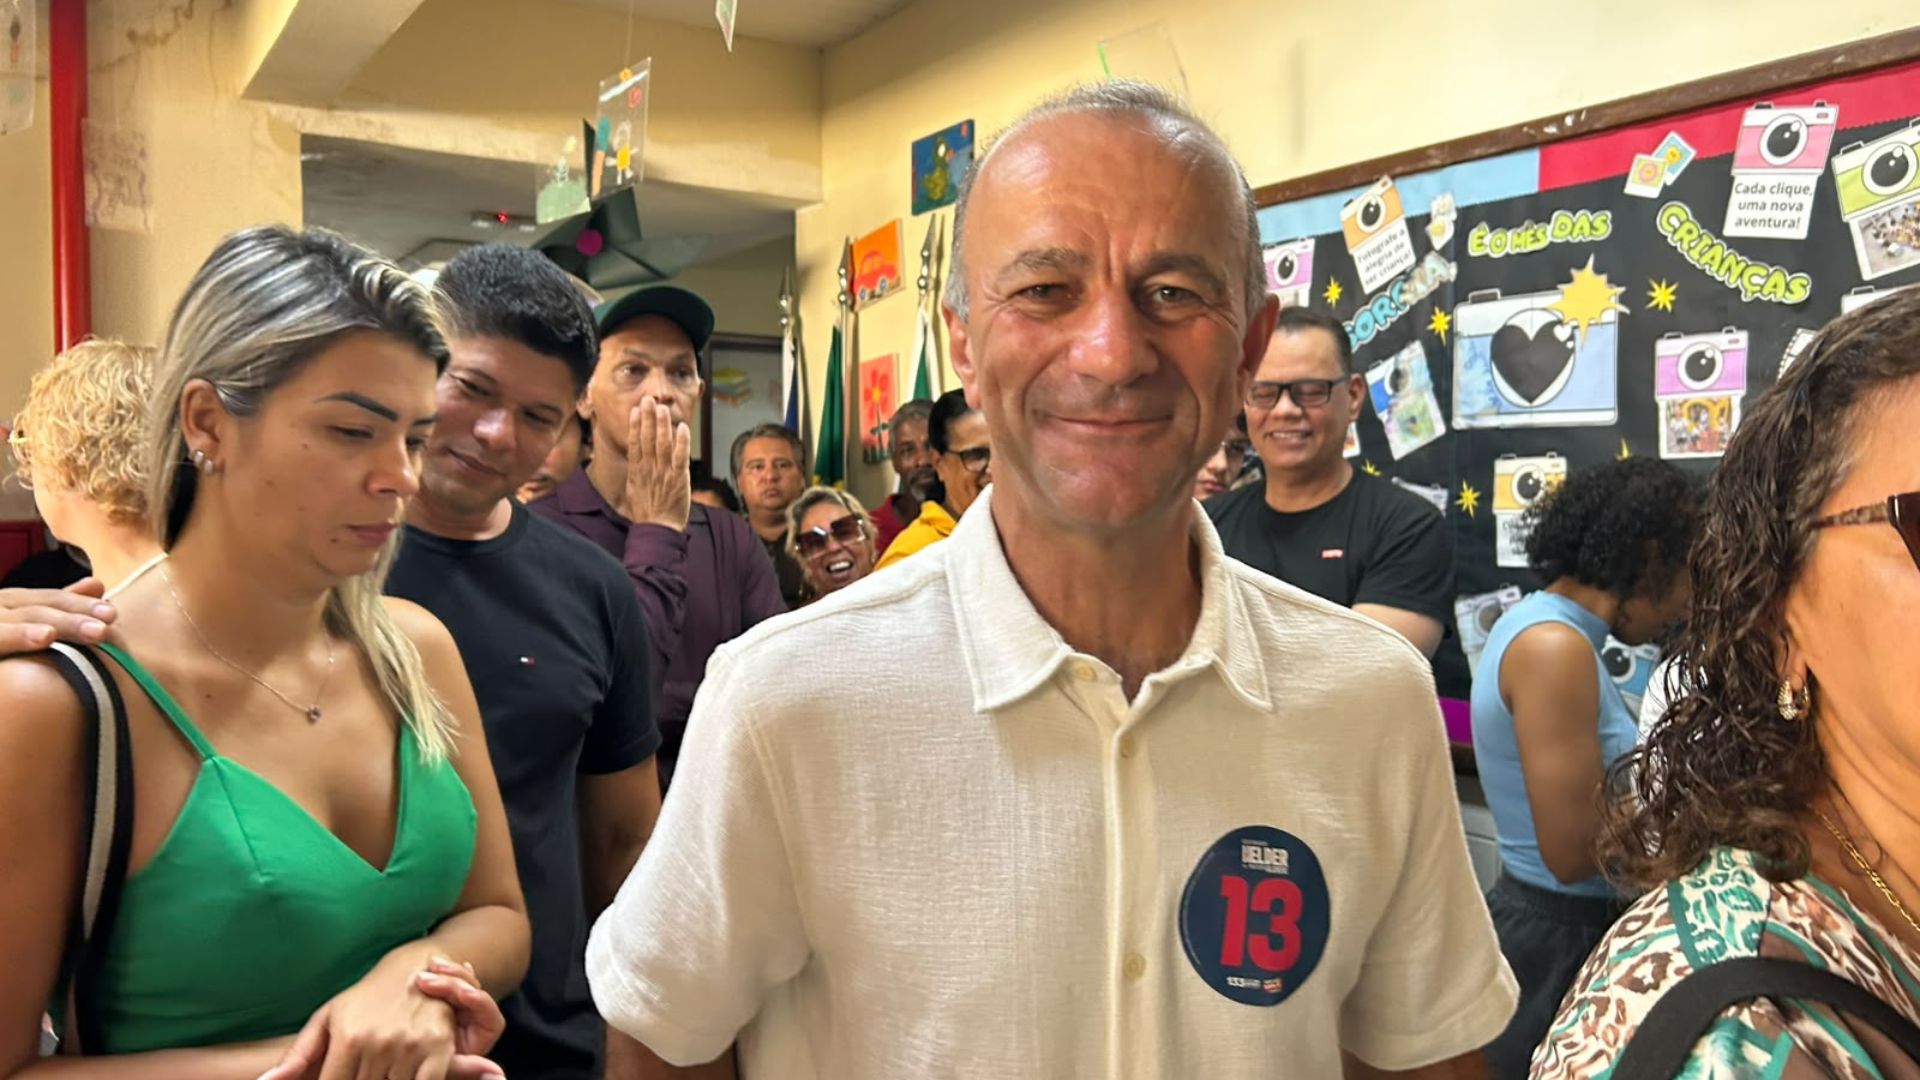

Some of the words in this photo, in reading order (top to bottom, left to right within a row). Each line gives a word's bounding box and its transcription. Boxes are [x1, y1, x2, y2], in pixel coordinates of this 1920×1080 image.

[1734, 182, 1766, 195] Cada
[1769, 182, 1813, 198] clique,
[1738, 201, 1767, 211] uma
[1770, 201, 1804, 212] nova
[1489, 229, 1508, 255] O
[1550, 211, 1611, 240] DAS
[1735, 217, 1801, 229] aventura!
[1658, 202, 1811, 302] CRIANÇAS
[1220, 874, 1303, 972] 13
